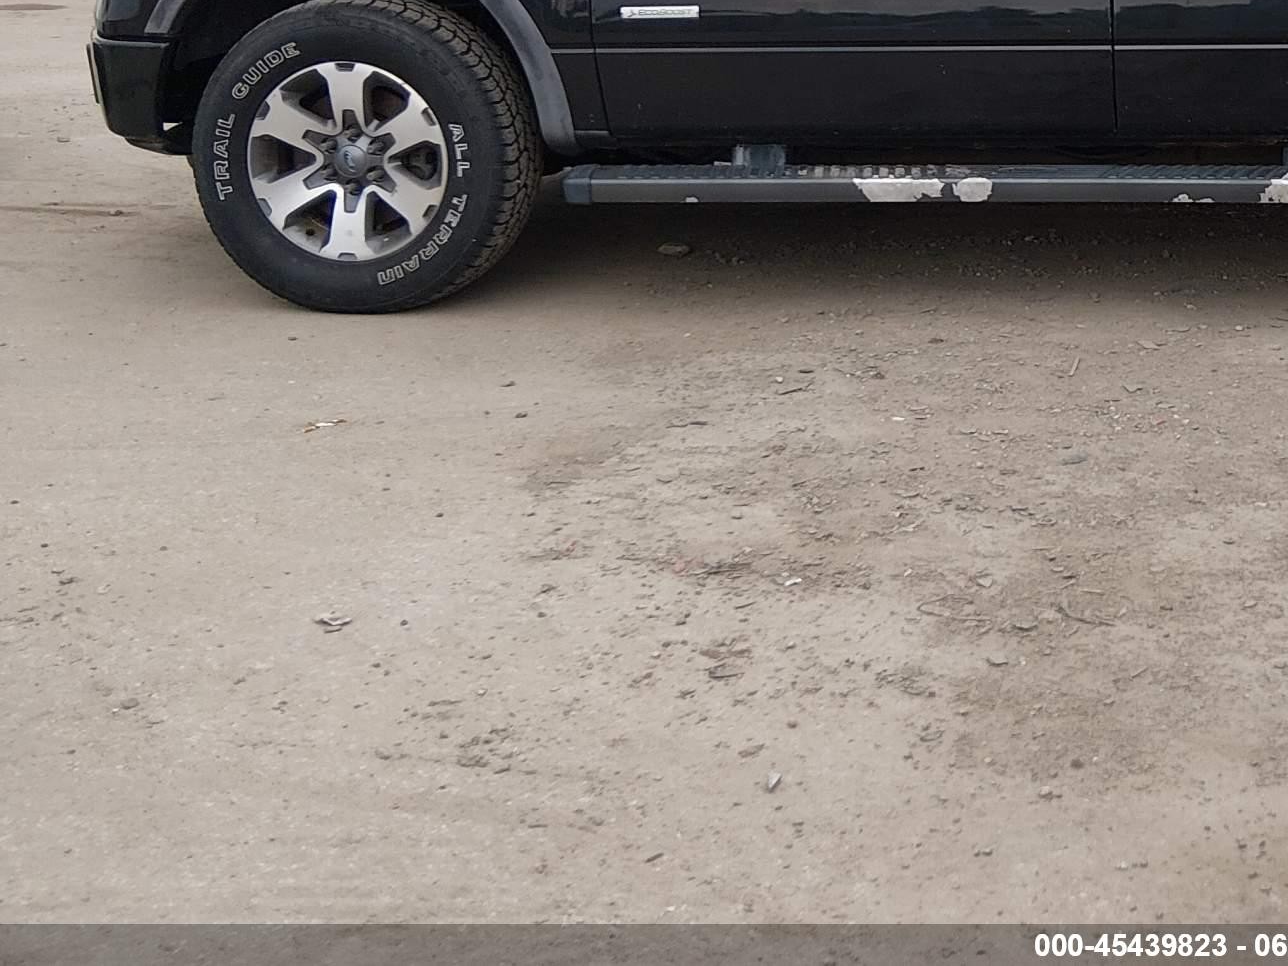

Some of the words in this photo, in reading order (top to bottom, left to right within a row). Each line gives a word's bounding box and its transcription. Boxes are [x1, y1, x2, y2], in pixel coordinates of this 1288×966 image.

[214, 113, 236, 201] TRAIL
[231, 42, 301, 99] GUIDE
[448, 123, 471, 178] ALL
[376, 193, 468, 285] TERRAIN
